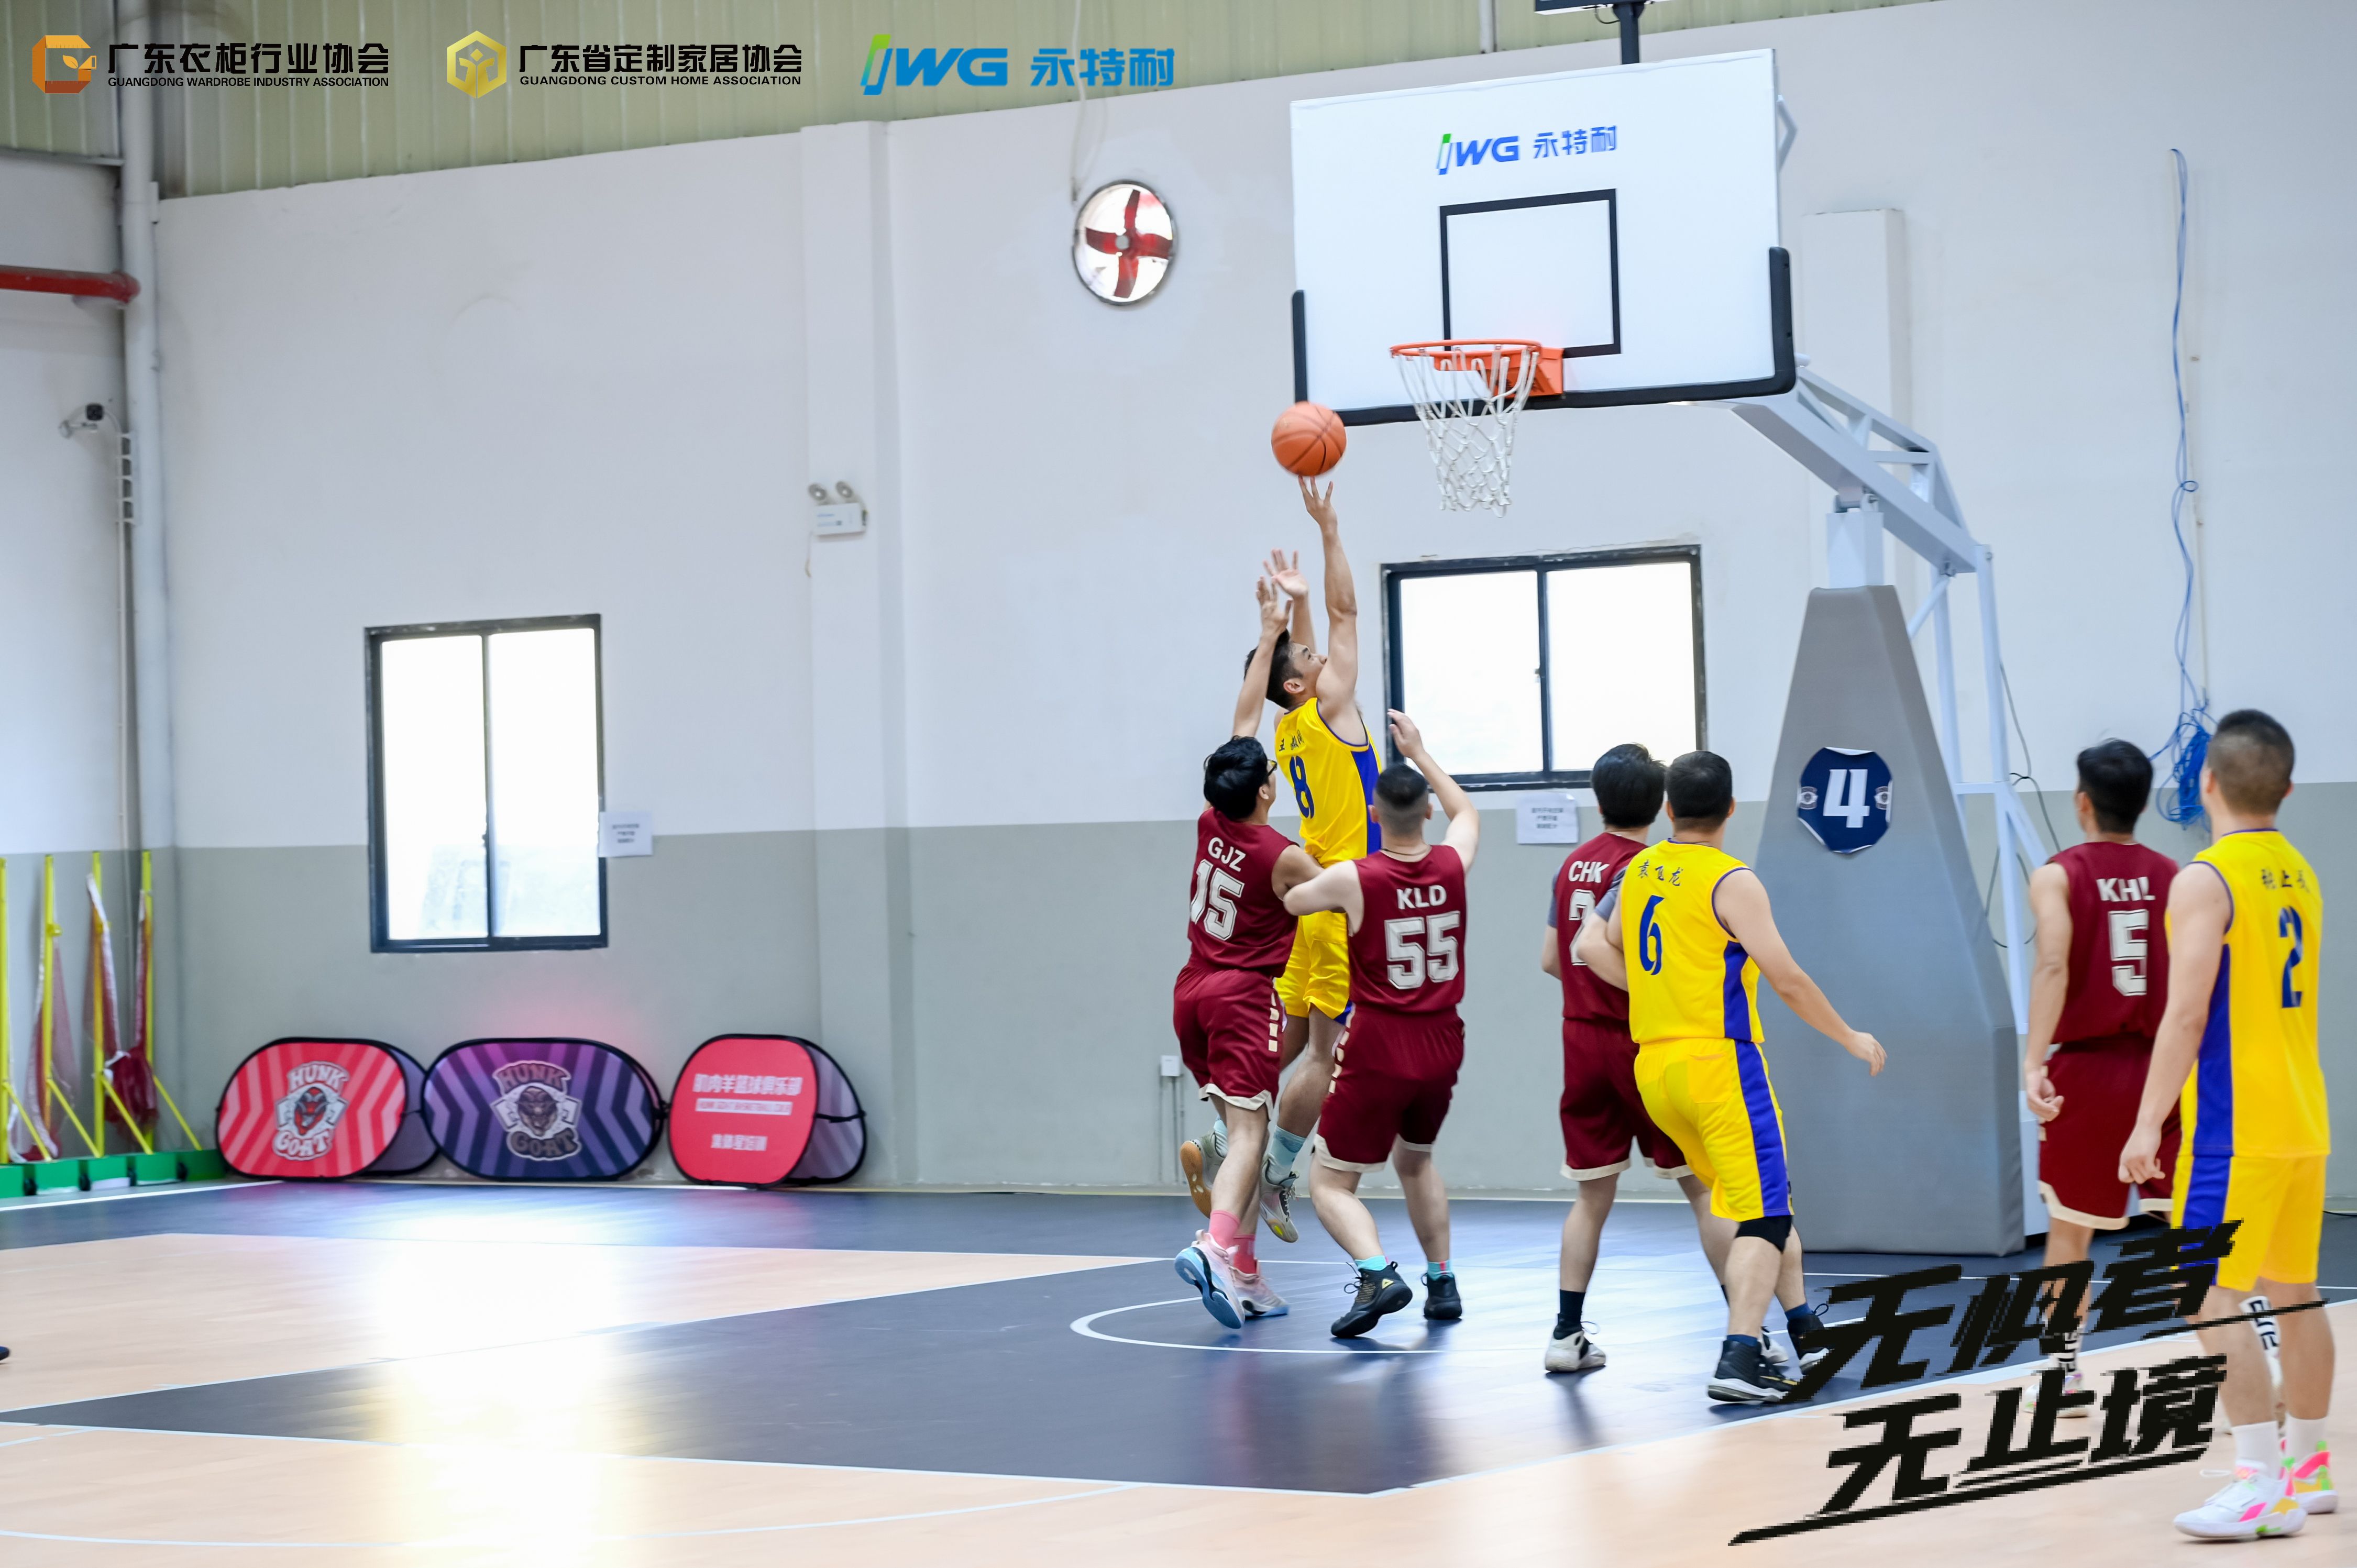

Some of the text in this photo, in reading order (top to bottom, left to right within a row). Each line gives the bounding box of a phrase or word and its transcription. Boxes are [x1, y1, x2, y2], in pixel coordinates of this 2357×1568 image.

[1533, 125, 1617, 159] 永特耐
[1290, 756, 1315, 819] 8
[1823, 769, 1870, 828] 4
[1207, 837, 1246, 872] GJZ
[1568, 860, 1610, 883] CHK
[1191, 859, 1245, 941] 15
[1397, 885, 1447, 910] KLD
[2096, 877, 2156, 902] KHL
[1384, 910, 1461, 990] 55
[1639, 895, 1665, 976] 6
[2108, 909, 2149, 997] 5
[2278, 906, 2303, 1009] 2
[289, 1064, 346, 1093] HUNK
[498, 1063, 568, 1094] HUNK
[274, 1129, 331, 1157] GOAT
[510, 1128, 578, 1158] GOAT
